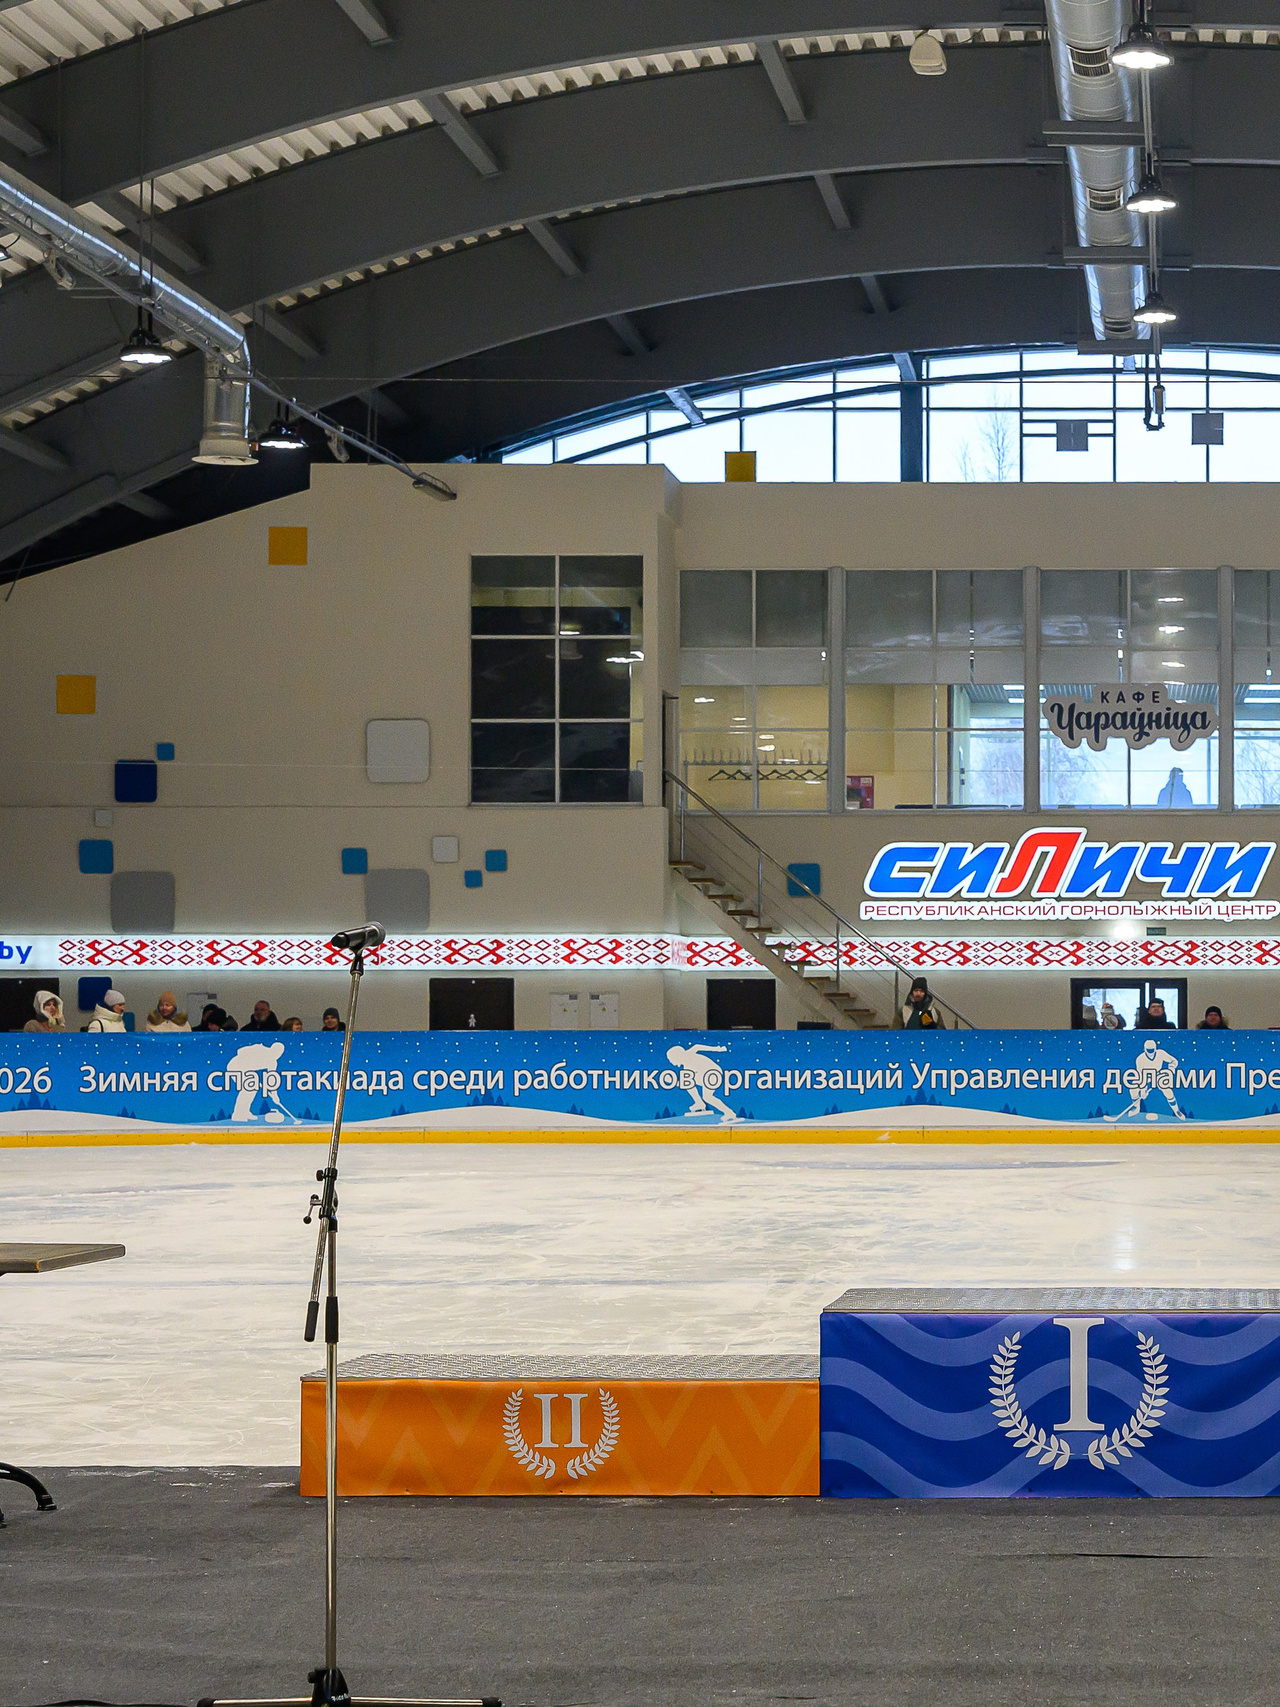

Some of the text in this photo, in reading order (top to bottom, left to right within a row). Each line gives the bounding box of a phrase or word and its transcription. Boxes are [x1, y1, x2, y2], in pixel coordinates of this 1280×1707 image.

[1100, 690, 1161, 704] КАФЕ
[1050, 702, 1212, 744] Чараўніца
[864, 903, 1278, 920] РЕСПУБЛИКАНСКИЙ ГОРНОЛЫЖНЫЙ ЦЕНТР
[79, 1065, 198, 1093] Зимняя
[412, 1069, 504, 1097] среди
[513, 1061, 697, 1097] работников
[703, 1062, 903, 1096] организаций
[910, 1062, 1095, 1096] Управления
[1102, 1068, 1216, 1094] делами
[1052, 1317, 1105, 1431] I
[533, 1393, 589, 1448] II
